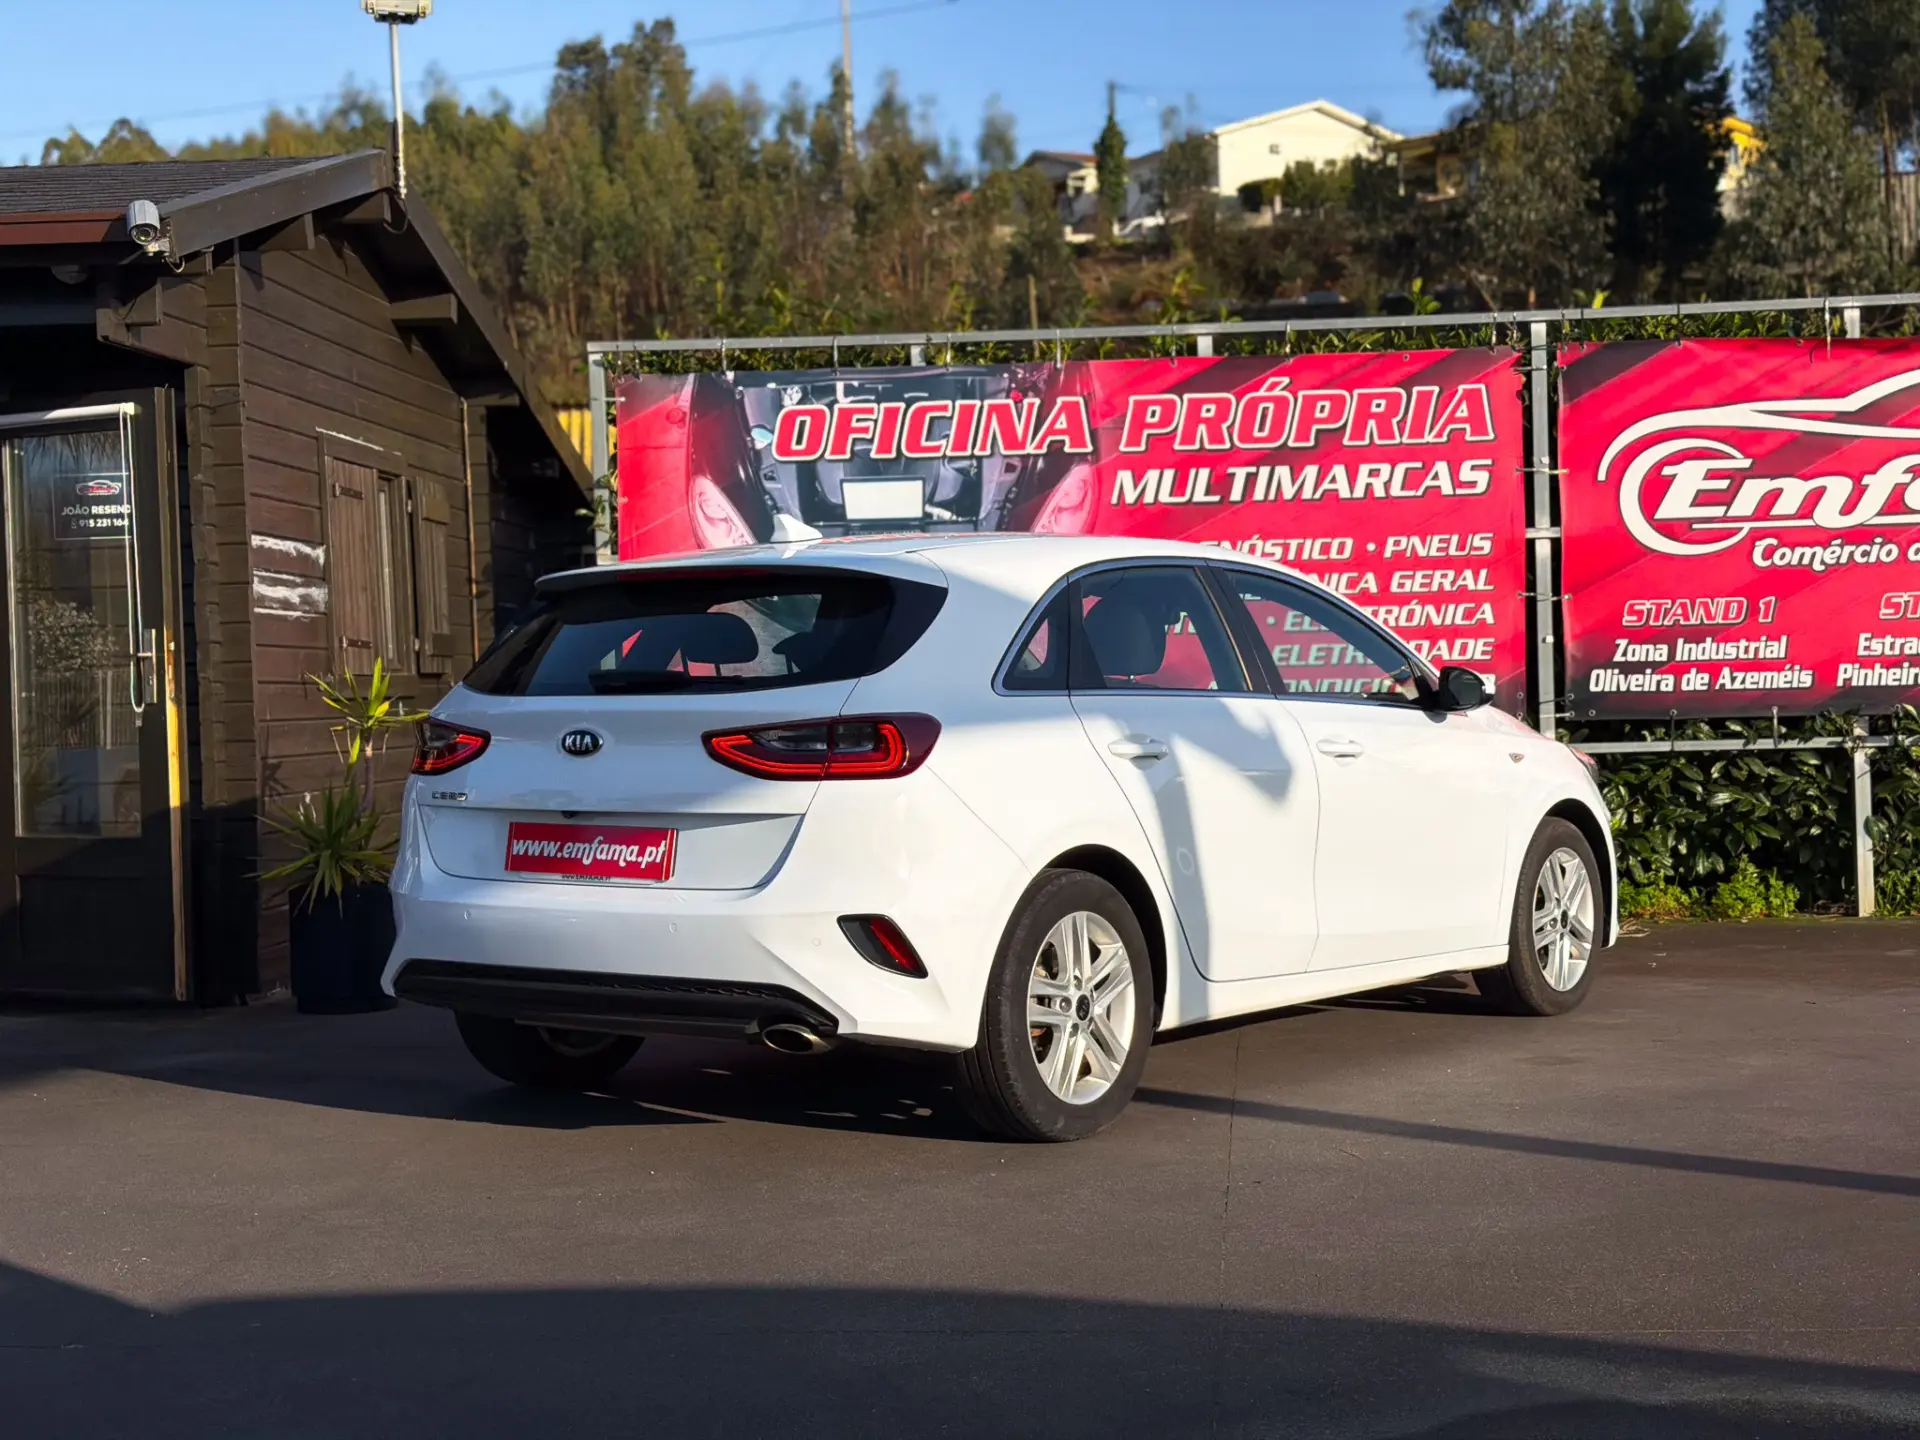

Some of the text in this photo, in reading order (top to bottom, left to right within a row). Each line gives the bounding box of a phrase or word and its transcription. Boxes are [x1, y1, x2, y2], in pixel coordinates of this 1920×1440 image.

[772, 377, 1496, 462] OFICINA PRÓPRIA
[1110, 458, 1493, 506] MULTIMARCAS
[61, 504, 90, 516] JOÃO
[79, 518, 95, 528] 915
[96, 518, 112, 528] 231
[1383, 532, 1493, 558] PNEUS
[1752, 537, 1900, 572] Comércio
[1390, 568, 1495, 593] GERAL
[1622, 596, 1776, 627] STAND 1
[1612, 635, 1788, 662] Zona Industrial
[1857, 632, 1920, 657] Estra
[1589, 664, 1814, 693] Oliveira de Azeméis
[1837, 662, 1920, 687] Pinheir
[565, 734, 594, 751] KIA
[512, 836, 667, 869] www.emfama.pt
